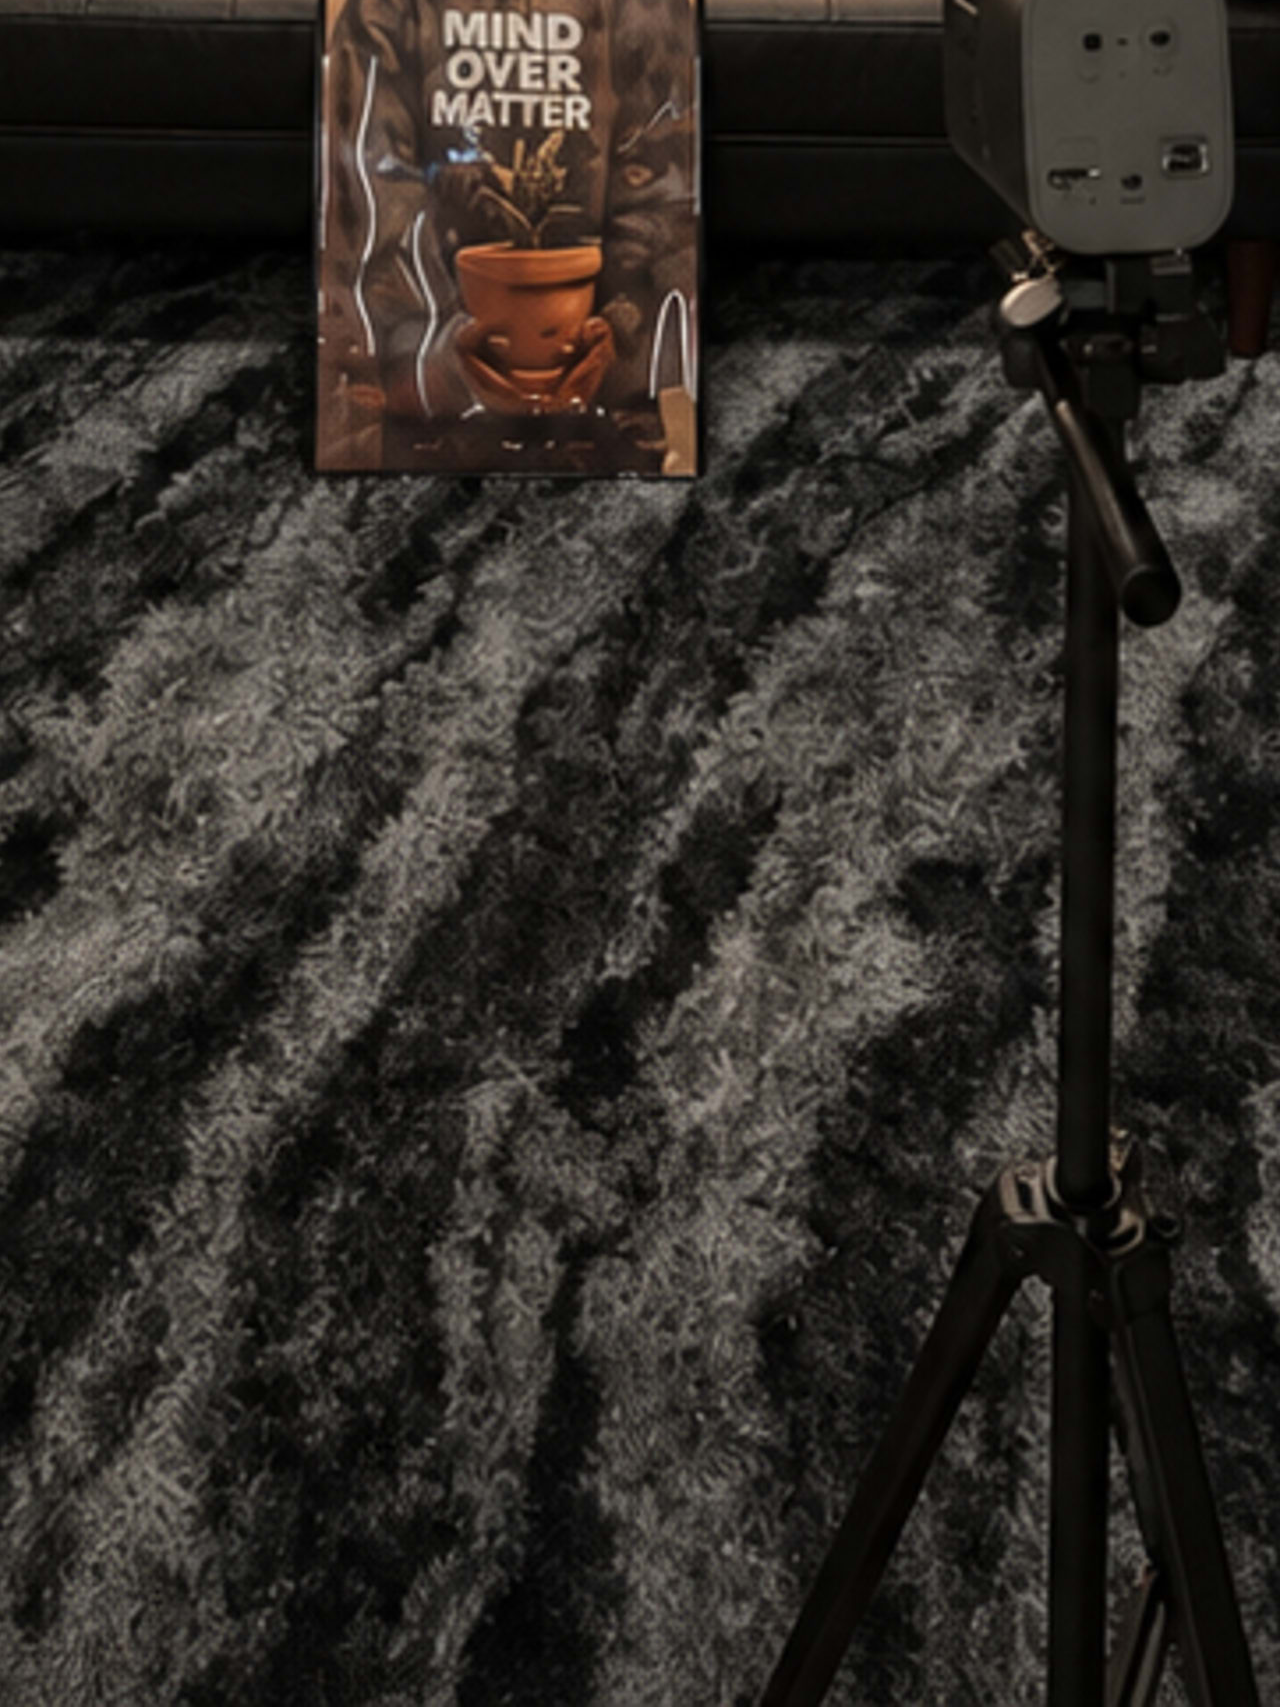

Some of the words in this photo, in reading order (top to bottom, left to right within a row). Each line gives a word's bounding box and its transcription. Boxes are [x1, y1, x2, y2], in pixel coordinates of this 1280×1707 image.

[443, 9, 583, 51] MIND
[445, 49, 583, 93] OVER
[431, 89, 592, 130] MATTER
